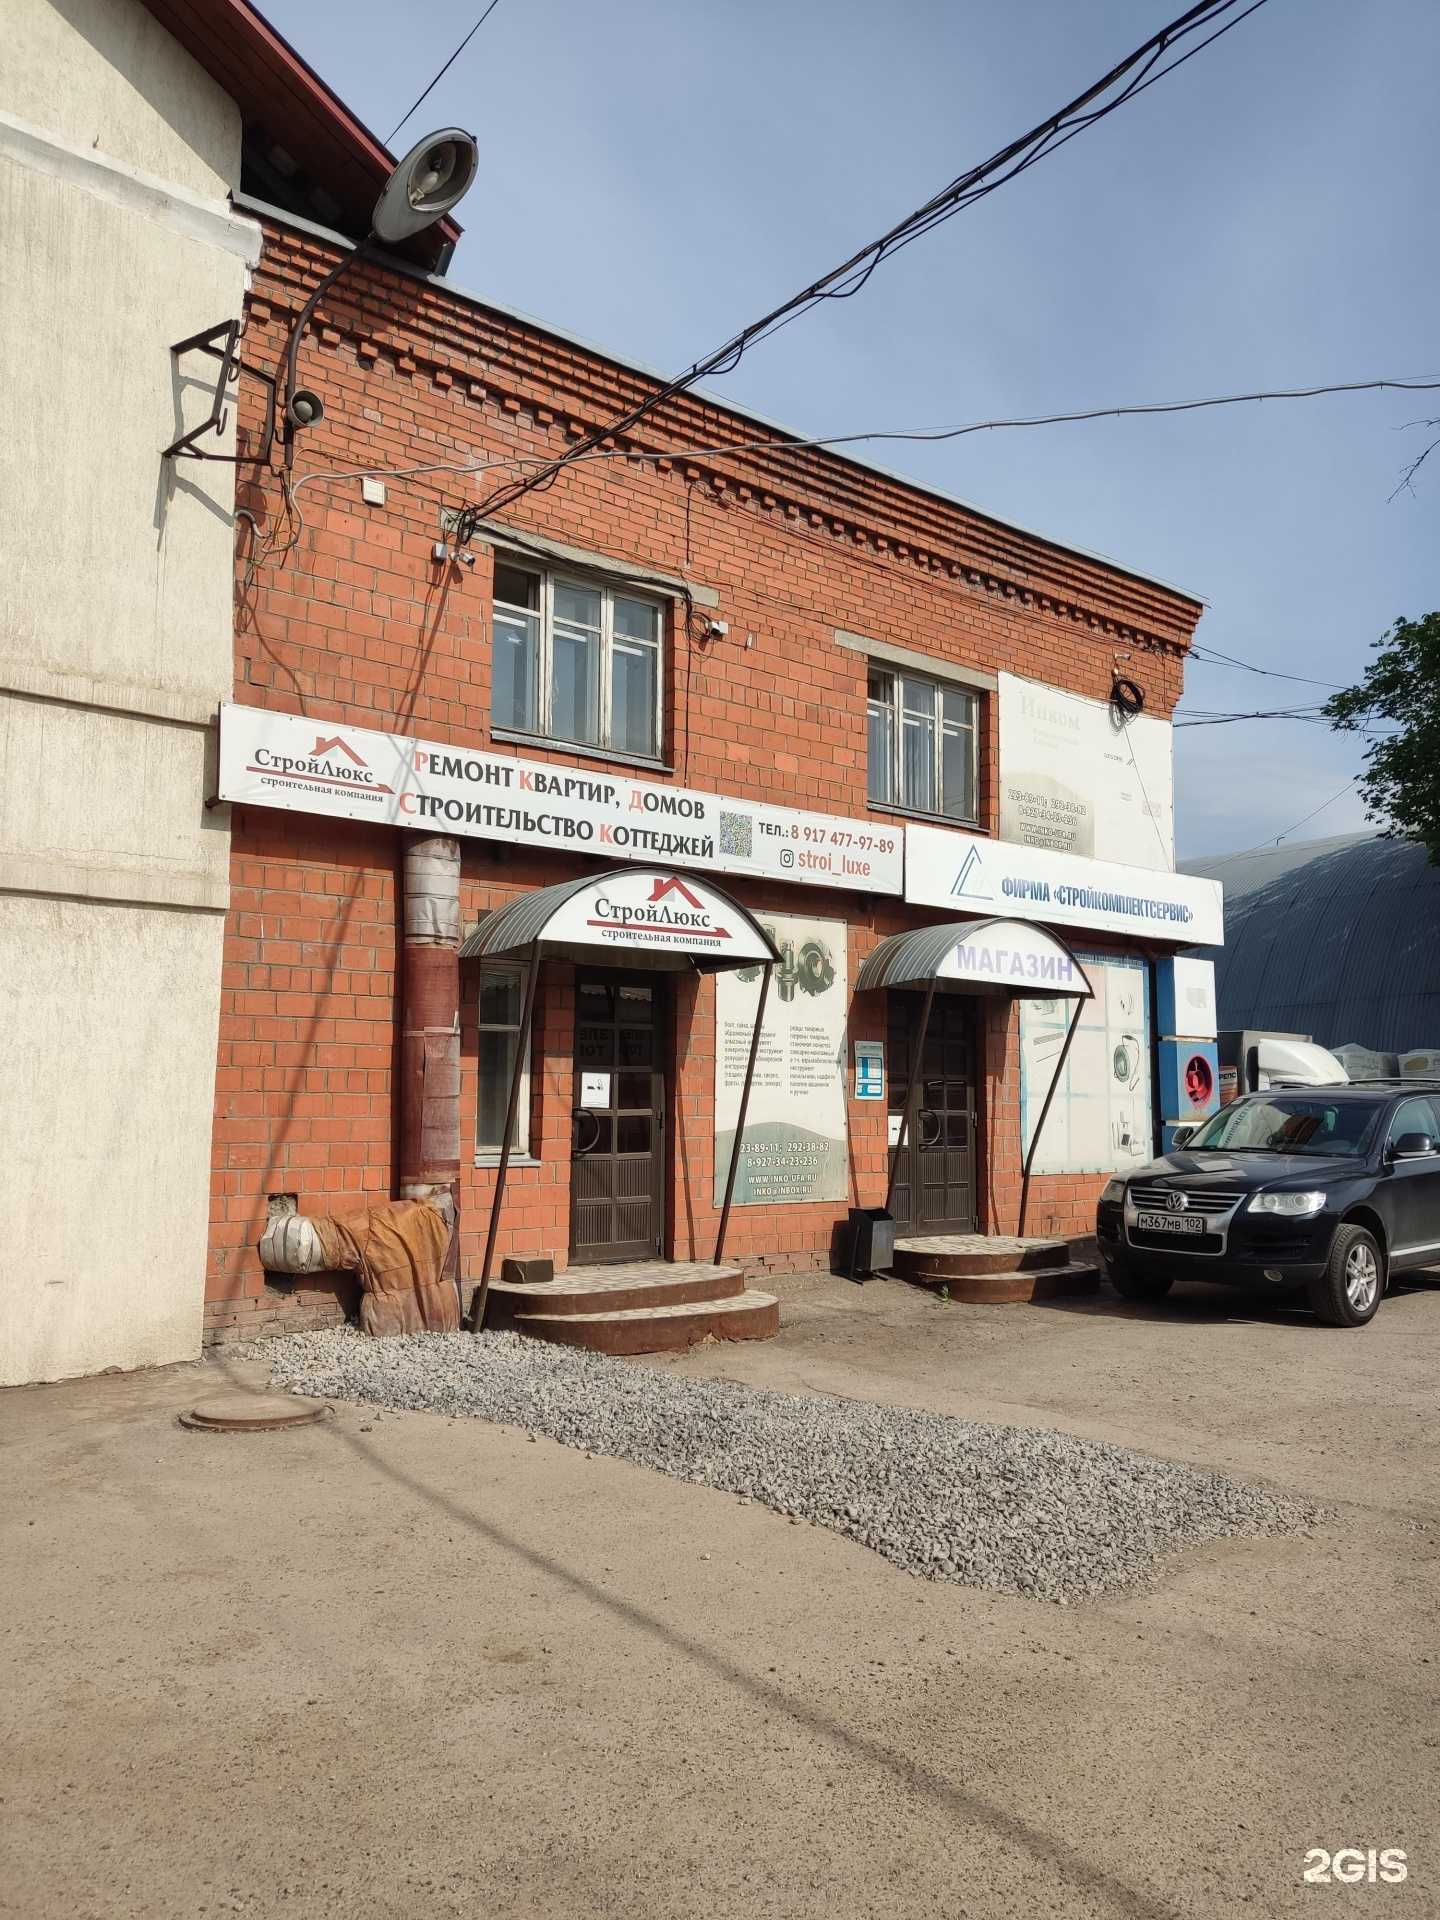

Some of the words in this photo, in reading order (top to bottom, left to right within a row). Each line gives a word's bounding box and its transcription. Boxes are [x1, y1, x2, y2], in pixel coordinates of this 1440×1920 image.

[255, 749, 373, 784] СтройЛюкс
[261, 775, 332, 795] строительная
[335, 789, 384, 803] компания
[414, 751, 514, 787] РЕМОНТ
[520, 770, 620, 808] КВАРТИР,
[629, 790, 705, 819] ДОМОВ
[400, 792, 593, 840] СТРОИТЕЛЬСТВО
[600, 822, 714, 858] КОТТЕДЖЕЙ
[803, 826, 826, 844] 917
[830, 832, 895, 854] 477-97-89
[798, 849, 871, 876] stroi_luxe
[595, 897, 710, 928] СтройЛюкс
[1001, 877, 1050, 902] ФИРМА
[1054, 884, 1193, 924] «СТРОЙКОМПЛЕКТСЕРВИС»
[601, 928, 671, 944] строительная
[673, 934, 721, 948] компания
[957, 944, 1073, 982] МАГАЗИН
